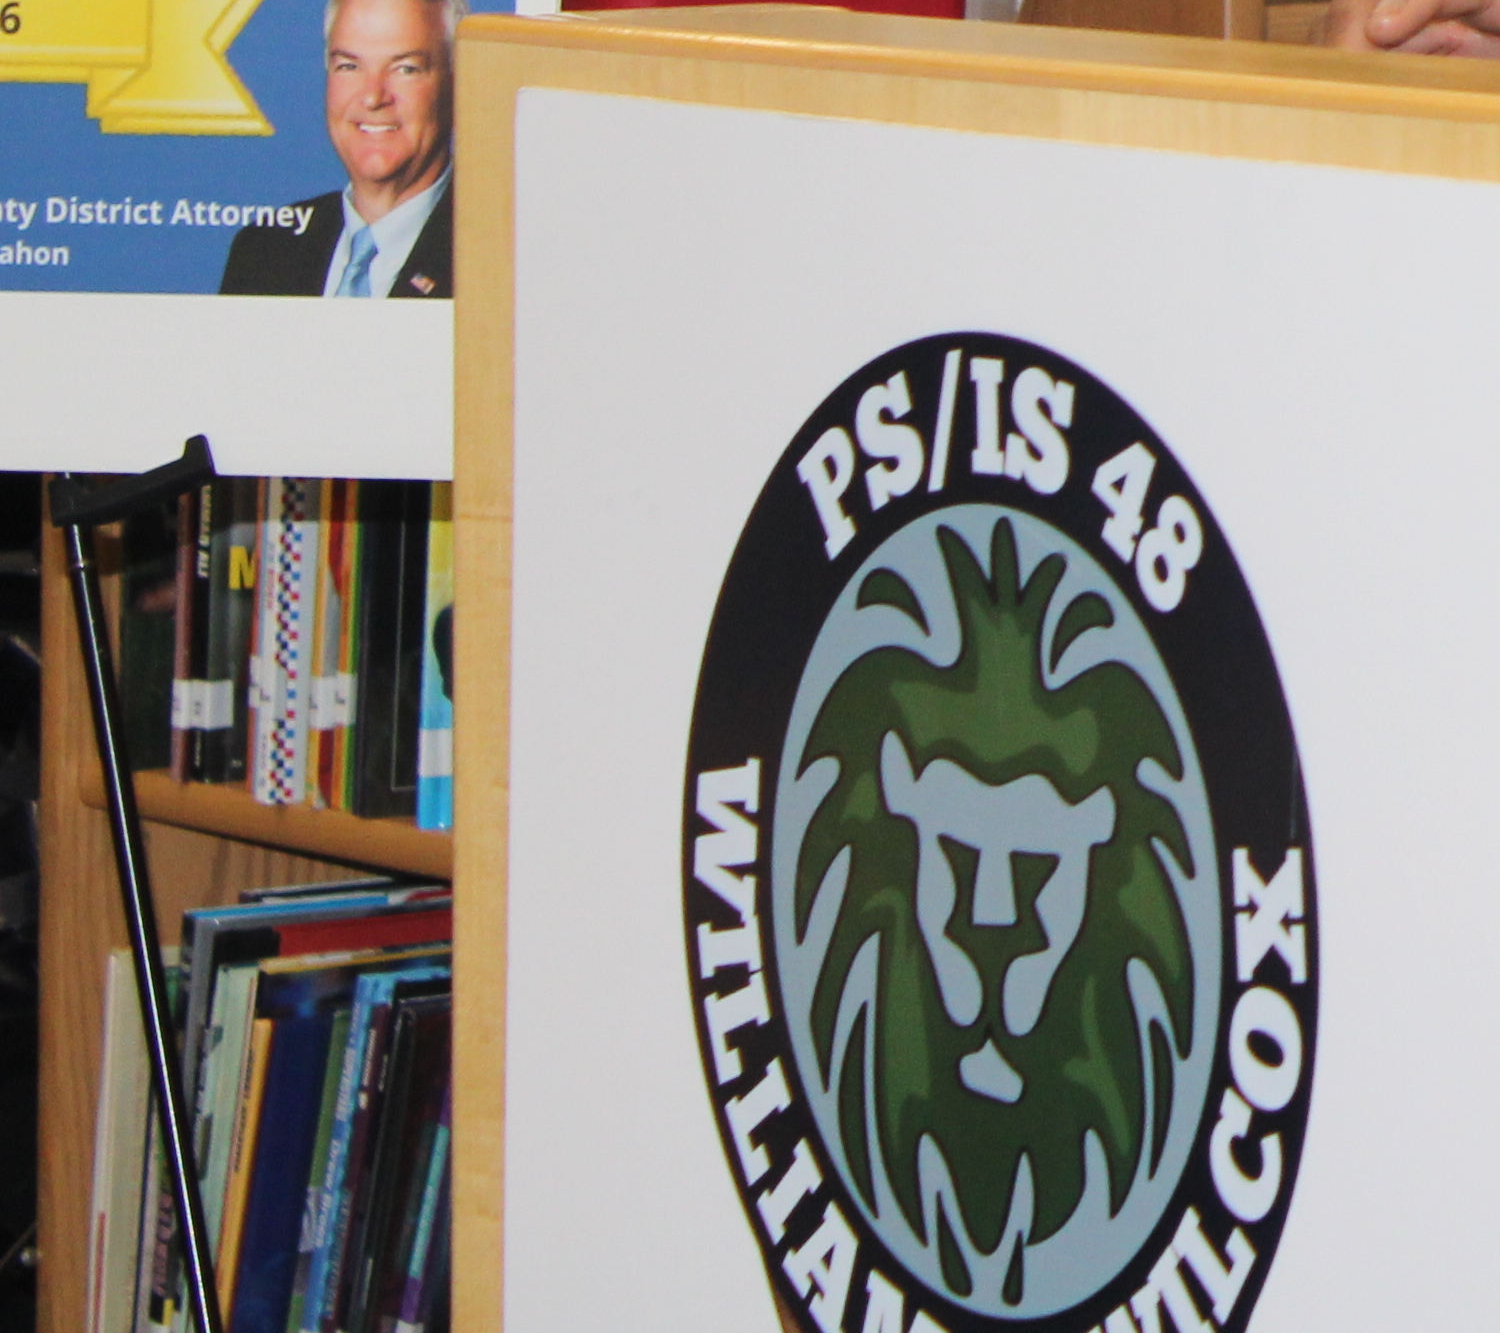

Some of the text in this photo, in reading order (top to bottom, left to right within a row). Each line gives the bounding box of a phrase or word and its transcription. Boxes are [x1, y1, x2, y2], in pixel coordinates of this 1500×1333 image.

[46, 196, 315, 235] District Attorney
[796, 349, 1203, 614] PS/IS 48
